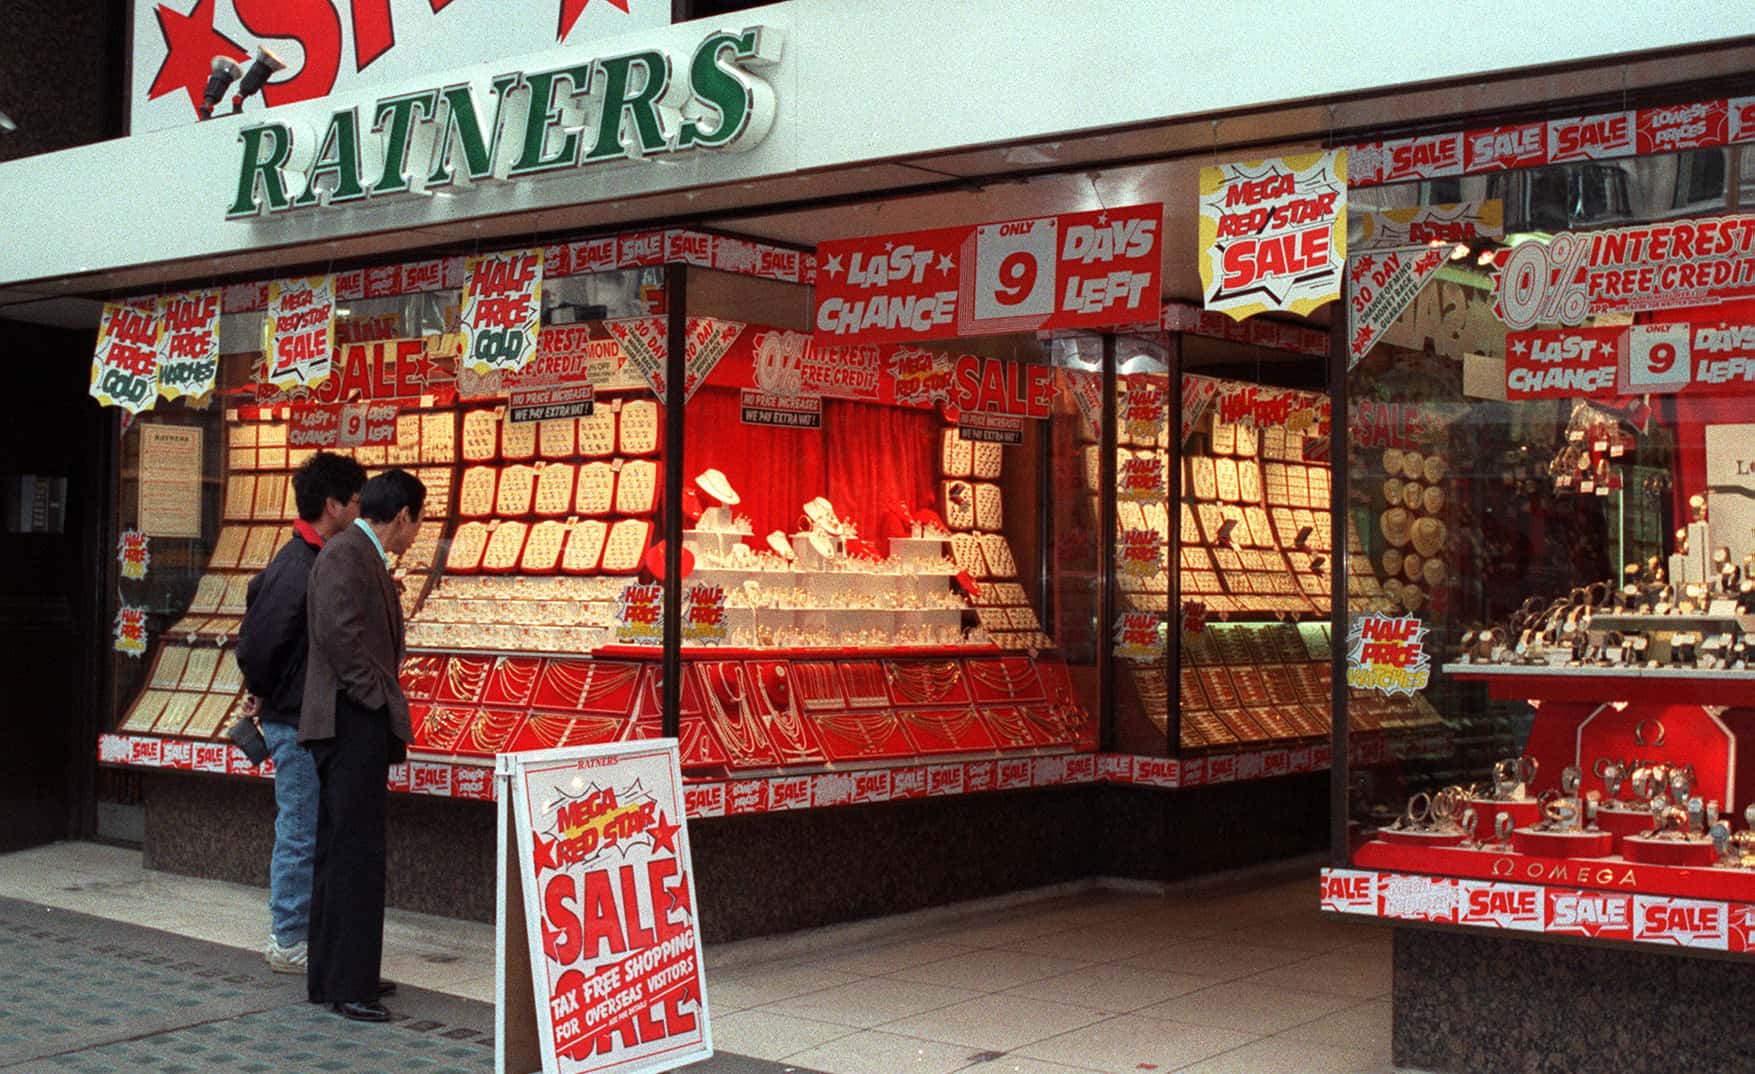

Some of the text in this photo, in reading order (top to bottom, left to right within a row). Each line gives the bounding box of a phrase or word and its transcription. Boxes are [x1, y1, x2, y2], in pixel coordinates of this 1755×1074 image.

[225, 28, 762, 220] RATNERS
[1652, 103, 1707, 128] LOWEST
[1392, 138, 1456, 172] SALE
[1474, 127, 1540, 164] SALE
[1558, 117, 1626, 152] SALE
[1655, 121, 1706, 144] PRICES
[1226, 173, 1295, 208] MEGA
[1216, 192, 1337, 238] RED STAR
[1000, 221, 1035, 237] ONLY
[1062, 219, 1156, 264] DAYS
[575, 242, 612, 268] SALE
[621, 234, 660, 258] SALE
[670, 234, 708, 256] SALE
[761, 250, 795, 272] SALE
[1589, 219, 1755, 268] INTEREST
[847, 245, 934, 289] LAST
[1223, 226, 1330, 290] SALE
[407, 264, 439, 287] SALE
[469, 255, 538, 298] HALF
[995, 251, 1038, 306] 9
[1352, 251, 1401, 313] 30 DAY
[1502, 232, 1588, 330] 0%
[1588, 268, 1655, 299] FREE
[1661, 258, 1755, 294] CREDIT
[280, 289, 313, 312] MEGA
[1063, 271, 1151, 314] LEFT
[1359, 292, 1387, 324] CHANGE
[1393, 261, 1412, 283] MIND
[1372, 275, 1413, 323] MONEY BACK
[1380, 282, 1419, 329] GUARANTEE
[164, 295, 218, 332] HALF
[275, 304, 332, 333] RED STAR
[474, 294, 532, 330] PRICE
[816, 290, 958, 335] CHANCE
[634, 319, 668, 361] 30 DAY
[696, 320, 715, 346] DAY
[1646, 323, 1672, 334] ONLY
[169, 330, 213, 360] PRICE
[277, 328, 327, 369] SALE
[474, 328, 524, 363] GOLD
[589, 342, 619, 359] MOND
[1530, 336, 1597, 363] LAST
[1648, 342, 1677, 374] 9
[159, 361, 216, 386] WATCHES
[317, 339, 425, 404] SALE
[537, 354, 584, 375] CREDIT
[757, 331, 801, 393] 0%
[897, 353, 933, 375] MEGA
[1696, 357, 1755, 384] LEFT
[102, 369, 148, 403] GOLD
[800, 365, 875, 387] FREE CREDIT
[895, 376, 920, 398] RED
[957, 356, 1049, 418] SALE
[1508, 366, 1617, 393] CHANCE
[513, 386, 591, 405] NO PRICE INCREASES
[1128, 390, 1161, 406] HALF
[1220, 387, 1258, 425] HALF
[301, 409, 330, 427] LAST
[368, 404, 395, 422] DAYS
[514, 408, 529, 421] WE
[530, 407, 544, 420] PAY
[745, 409, 758, 421] WE
[1127, 405, 1161, 421] PRICE
[1254, 391, 1292, 429] PRICE
[290, 429, 337, 445] CHANCE
[347, 415, 360, 436] 9
[368, 425, 394, 442] LEFT
[1359, 400, 1418, 449] SALE
[1127, 458, 1160, 474] HALF
[1125, 474, 1161, 490] PRICE
[1125, 530, 1160, 546] HALF
[1124, 545, 1160, 561] PRICE
[625, 586, 661, 605] HALF
[690, 586, 724, 605] HALF
[624, 605, 661, 624] PRICE
[689, 606, 724, 625] PRICE
[1123, 613, 1158, 629] HALF
[1122, 629, 1158, 645] PRICE
[1361, 618, 1420, 642] HALF
[1360, 643, 1421, 668] PRICE
[1347, 667, 1430, 690] WATCHES
[133, 741, 158, 759] SALE
[164, 743, 190, 761] SALE
[196, 747, 224, 764] SALE
[577, 755, 618, 770] RATNERS
[414, 766, 448, 787] SALE
[774, 780, 807, 803] SALE
[856, 775, 887, 797] SALE
[895, 770, 926, 792] SALE
[932, 767, 961, 787] SALE
[1001, 764, 1029, 783] SALE
[1065, 757, 1092, 775] SALE
[1139, 761, 1178, 780] SALE
[1593, 757, 1699, 788] OMA
[557, 787, 618, 834] MEGA
[685, 786, 721, 811] SALE
[556, 801, 657, 867] RED STAR
[1527, 862, 1638, 887] OMEGA
[545, 858, 685, 966] SALE
[1469, 889, 1537, 915] SALE
[1554, 896, 1626, 924] SALE
[1645, 905, 1719, 932] SALE
[550, 929, 695, 1020] TAX FREE SHOPPING
[555, 956, 695, 1044] FOR OVERSEAS VISITORS
